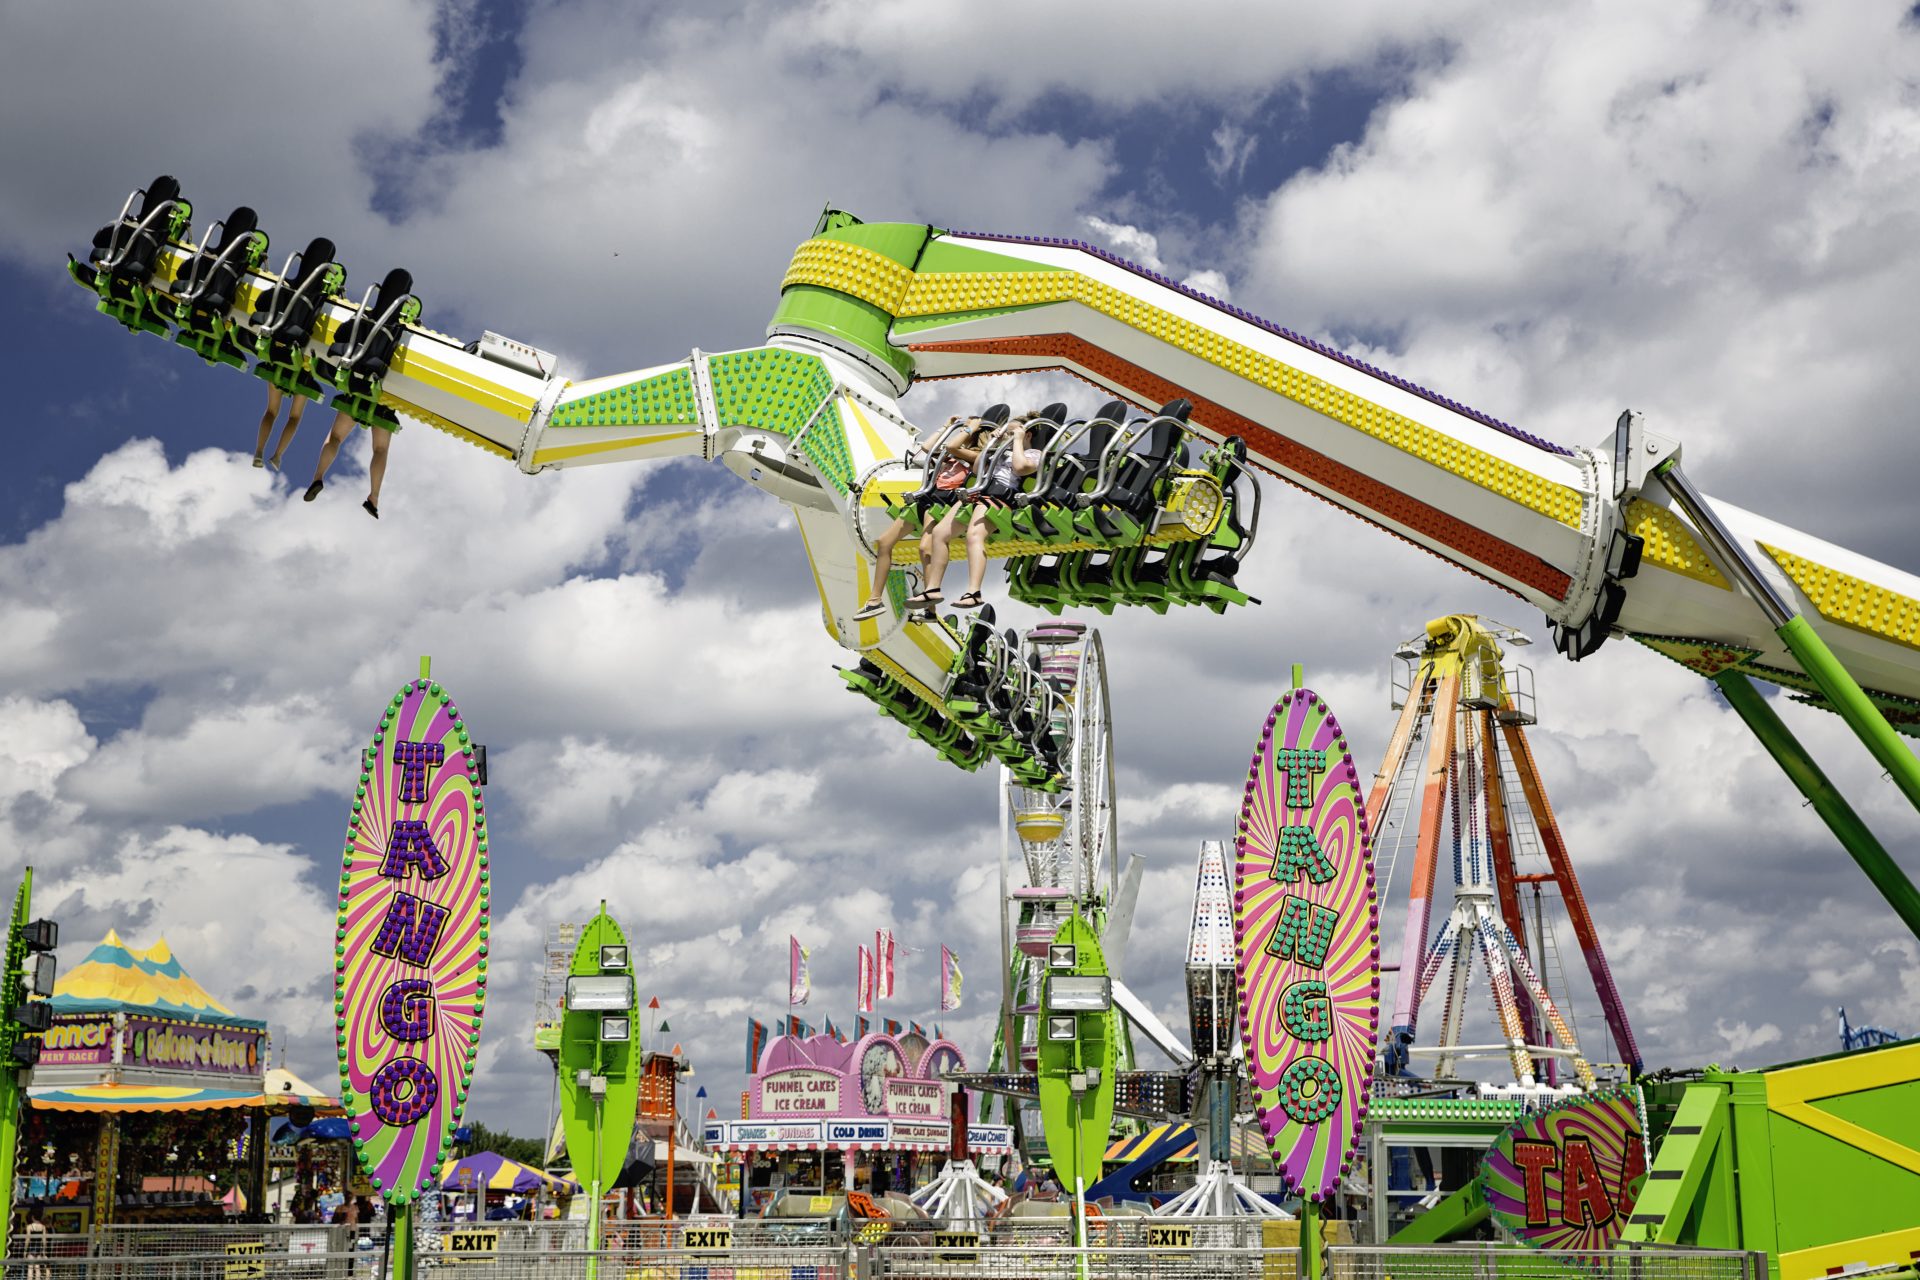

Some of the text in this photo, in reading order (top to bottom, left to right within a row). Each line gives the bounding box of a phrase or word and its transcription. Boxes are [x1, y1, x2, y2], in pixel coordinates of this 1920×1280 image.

[370, 741, 451, 1127] TANGO
[1265, 748, 1343, 1124] TANGO
[42, 1022, 111, 1049] inner
[40, 1051, 99, 1062] VERY RACE!
[766, 1080, 836, 1093] FUNNEL CAKES
[889, 1084, 938, 1098] FUNNEL CAKES
[775, 1098, 826, 1110] ICE CREAM
[895, 1102, 931, 1114] ICE CREAM
[778, 1127, 815, 1140] SUNDAES
[833, 1126, 884, 1138] COLD DRINKS
[452, 1235, 496, 1250] EXIT
[685, 1231, 730, 1247] EXIT
[935, 1235, 978, 1247] EXIT
[1150, 1229, 1190, 1246] EXIT
